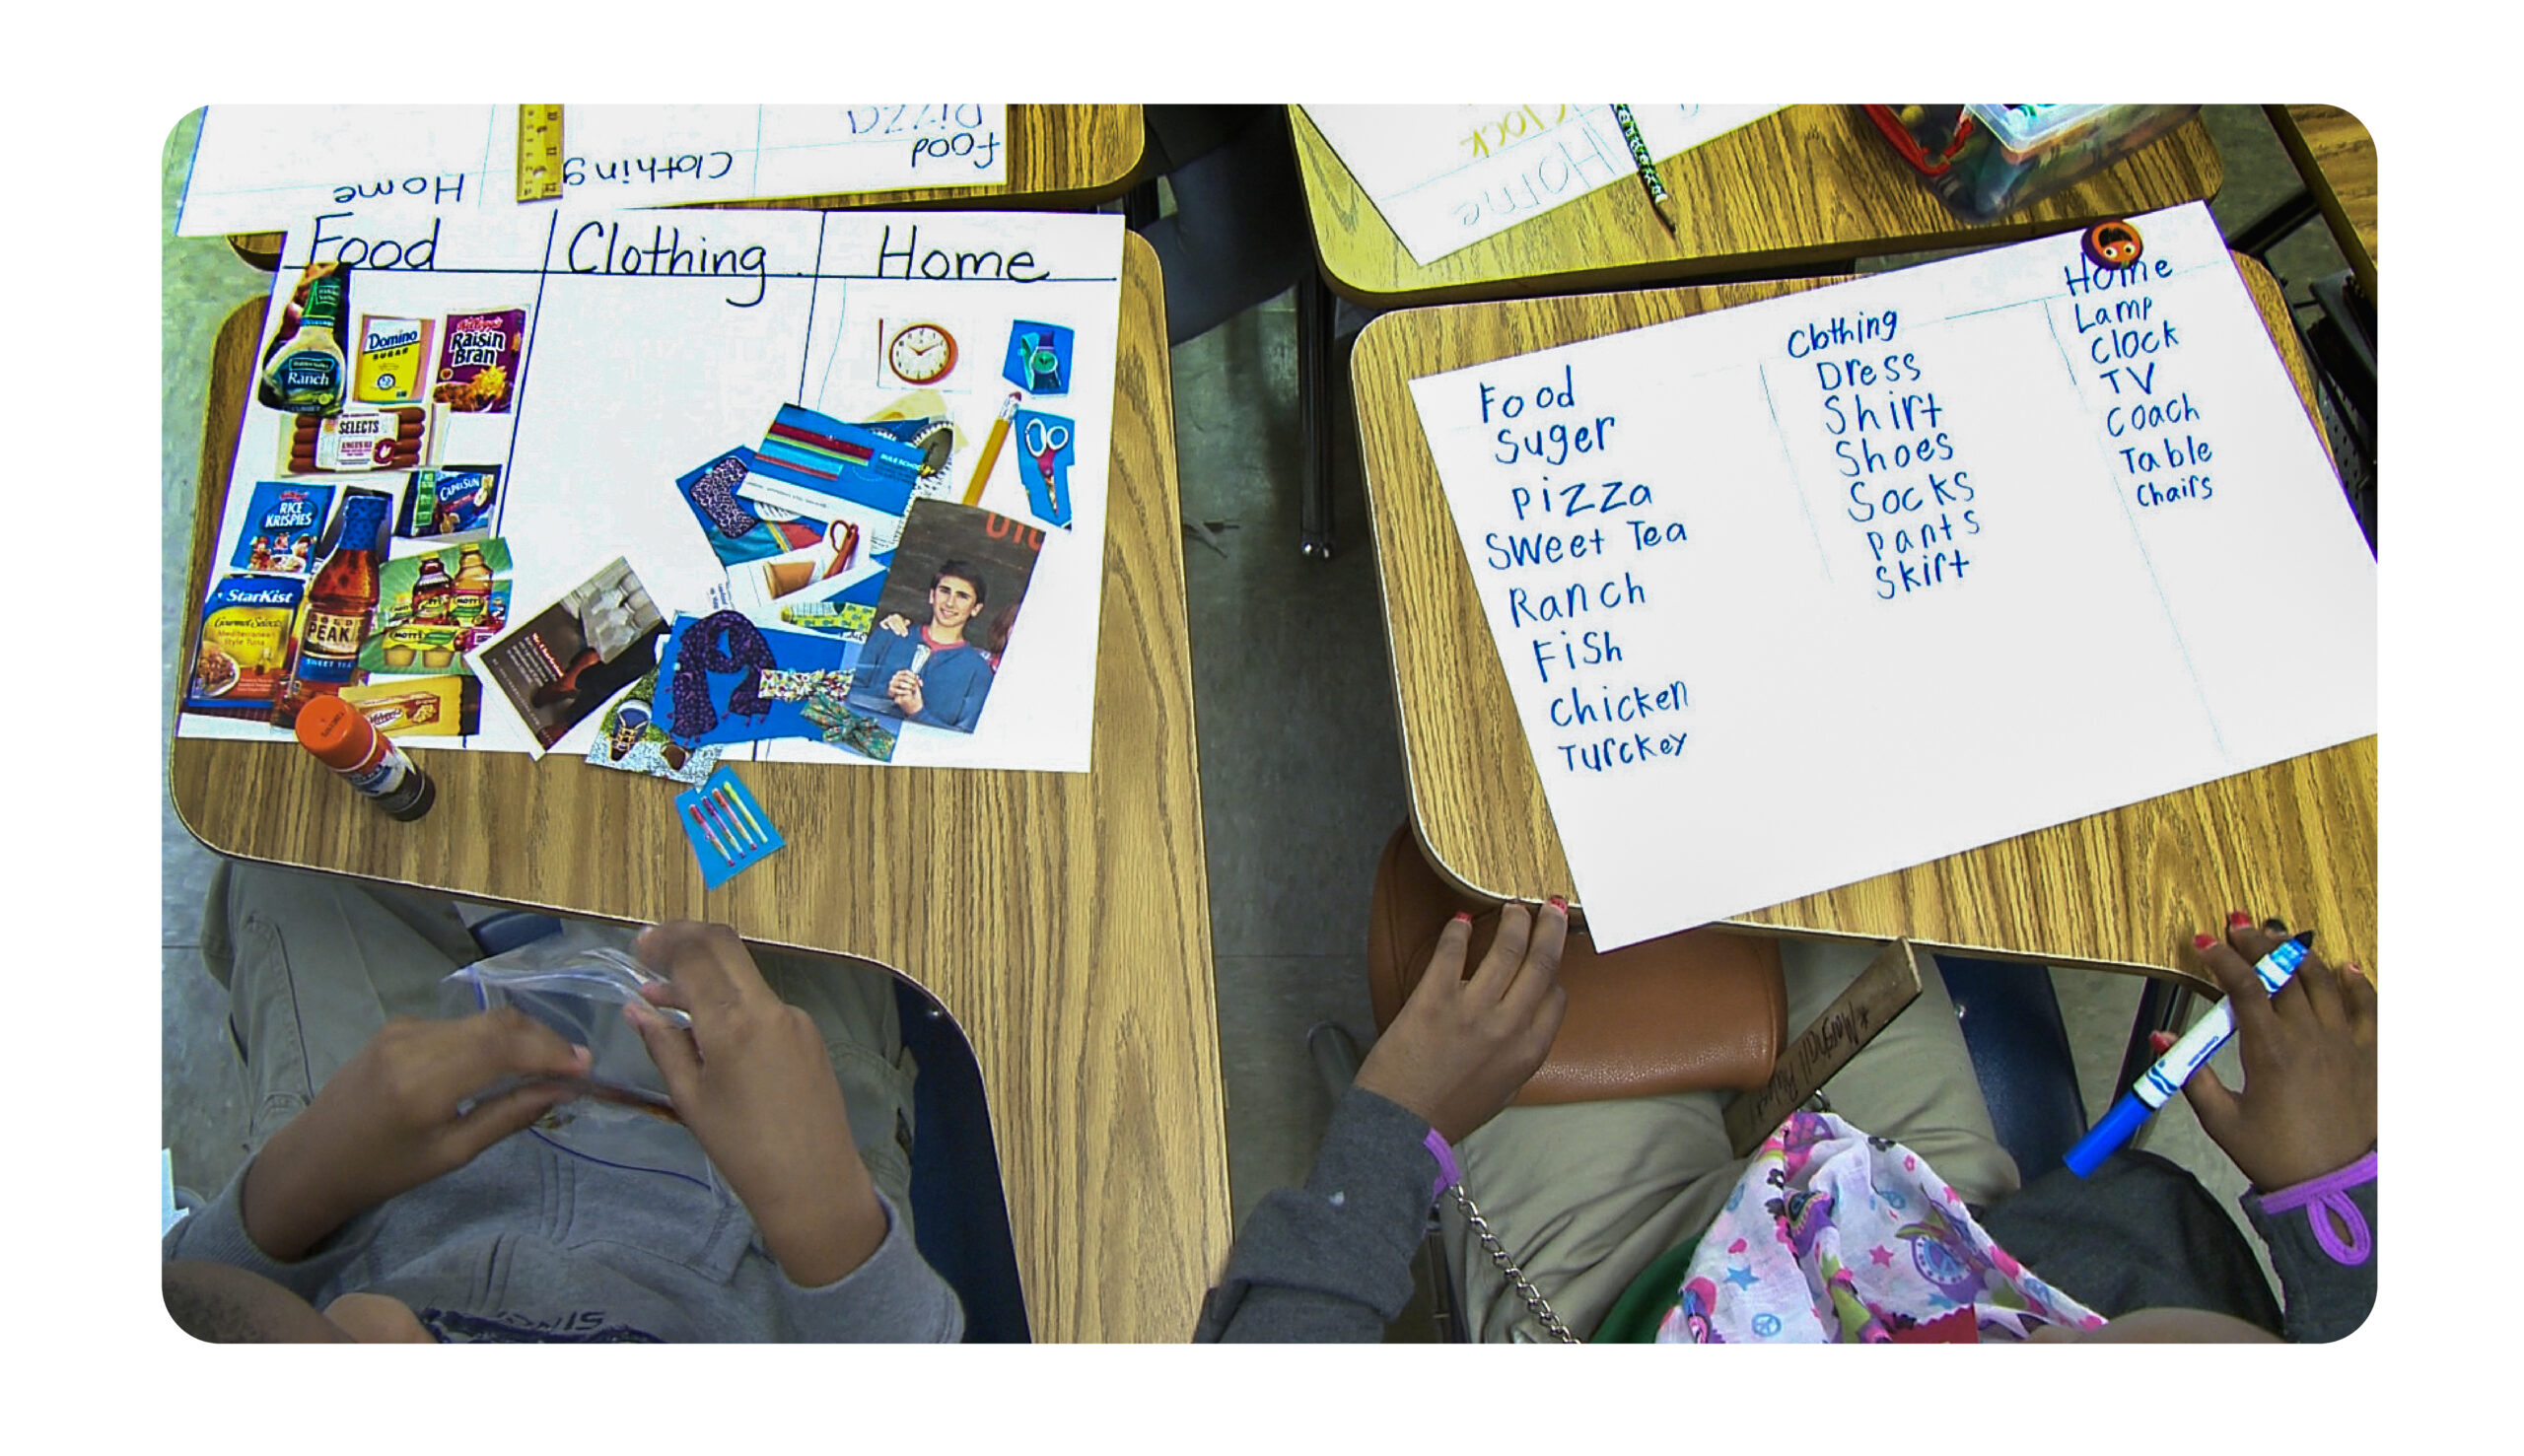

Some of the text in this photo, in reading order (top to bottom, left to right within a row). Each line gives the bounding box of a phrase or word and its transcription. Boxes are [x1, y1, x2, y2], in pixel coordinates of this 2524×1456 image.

[563, 152, 733, 185] Clothing
[333, 173, 464, 205] Home
[312, 211, 441, 271] Food
[877, 225, 1051, 284] Home
[568, 221, 767, 307] Clothing
[2075, 297, 2152, 333] Lamp
[368, 329, 418, 350] Domino
[451, 330, 506, 351] Raisin
[453, 347, 496, 366] Bran
[1817, 353, 1921, 390] Dress
[288, 372, 329, 385] Ranch
[1481, 365, 1575, 423] Food
[2100, 362, 2155, 394] TV
[339, 420, 380, 435] SELECTS
[1825, 391, 1942, 435] Shirt
[1836, 433, 1953, 477] Shoes
[2120, 435, 2212, 473] Table
[280, 502, 305, 514] RICE
[1848, 471, 1974, 522] Socks
[264, 513, 314, 528] KRISPIES
[1628, 520, 1687, 550] Tea
[226, 589, 295, 602] StarKist
[1510, 572, 1645, 628] Ranch
[307, 621, 351, 644] PEAK
